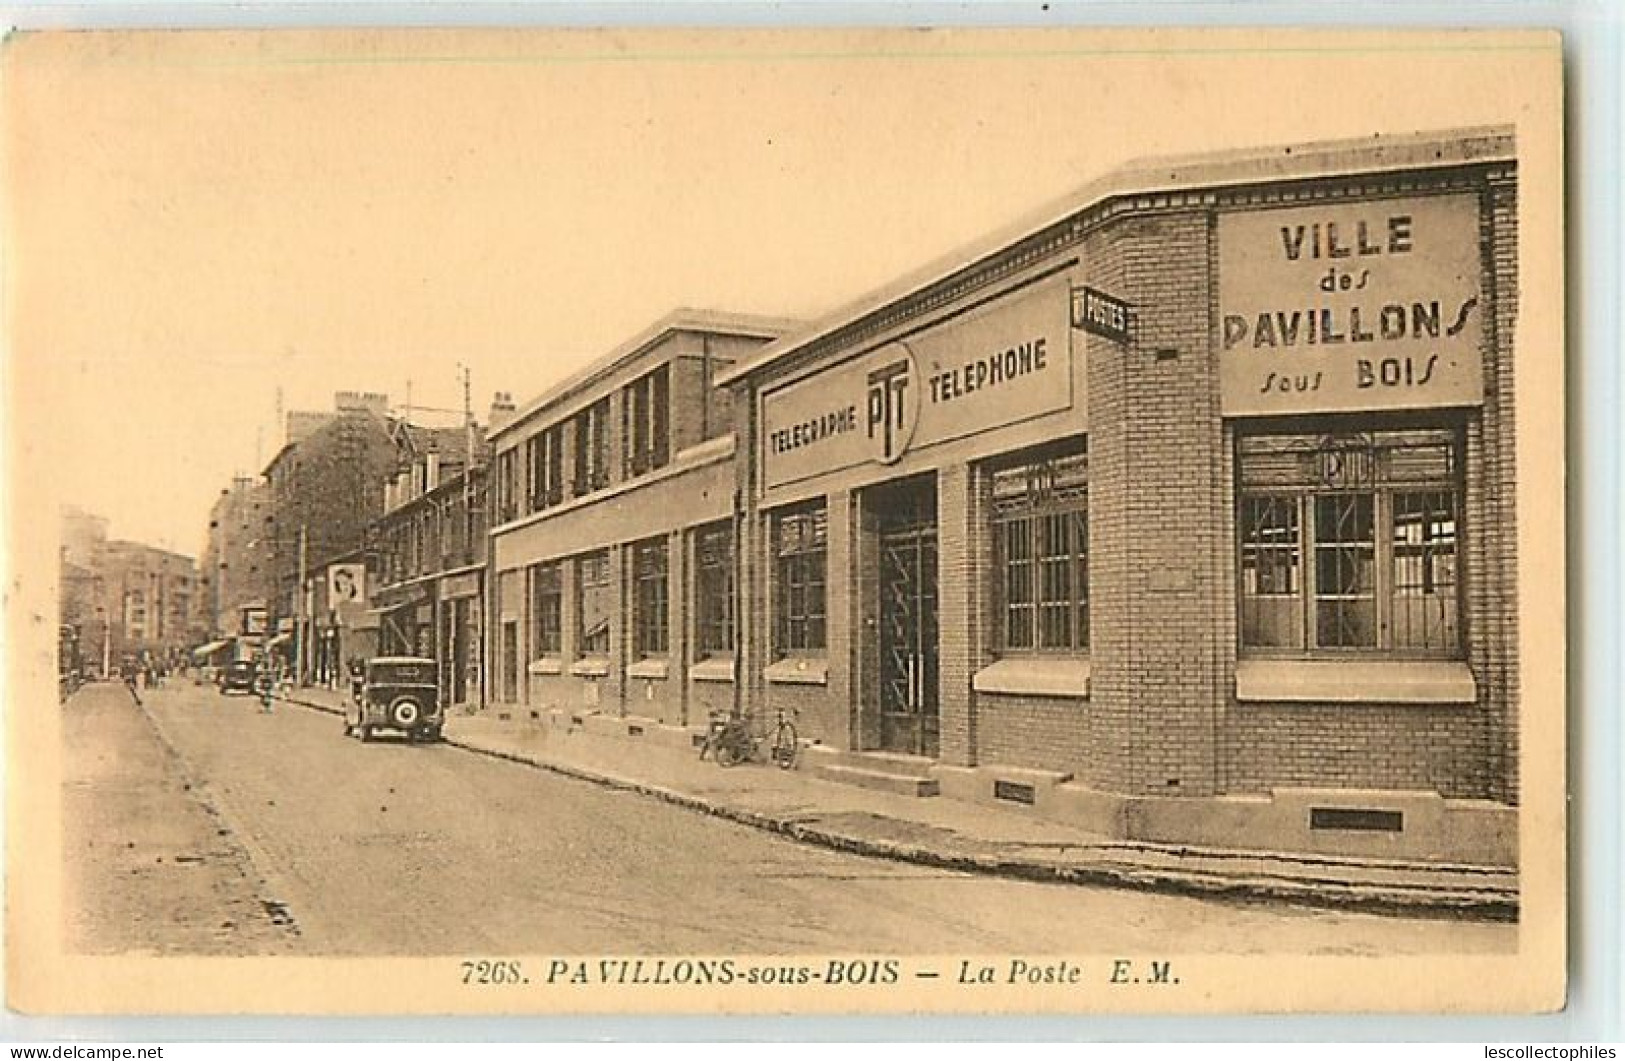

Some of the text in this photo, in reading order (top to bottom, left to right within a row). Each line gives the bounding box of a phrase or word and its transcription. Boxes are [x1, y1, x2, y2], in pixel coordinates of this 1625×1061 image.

[1281, 215, 1412, 260] VILLE
[1319, 268, 1370, 292] des
[1087, 294, 1124, 332] POSTES
[1223, 298, 1478, 350] PAVILLONS
[1356, 354, 1438, 388] BOIS
[868, 358, 909, 458] PTT
